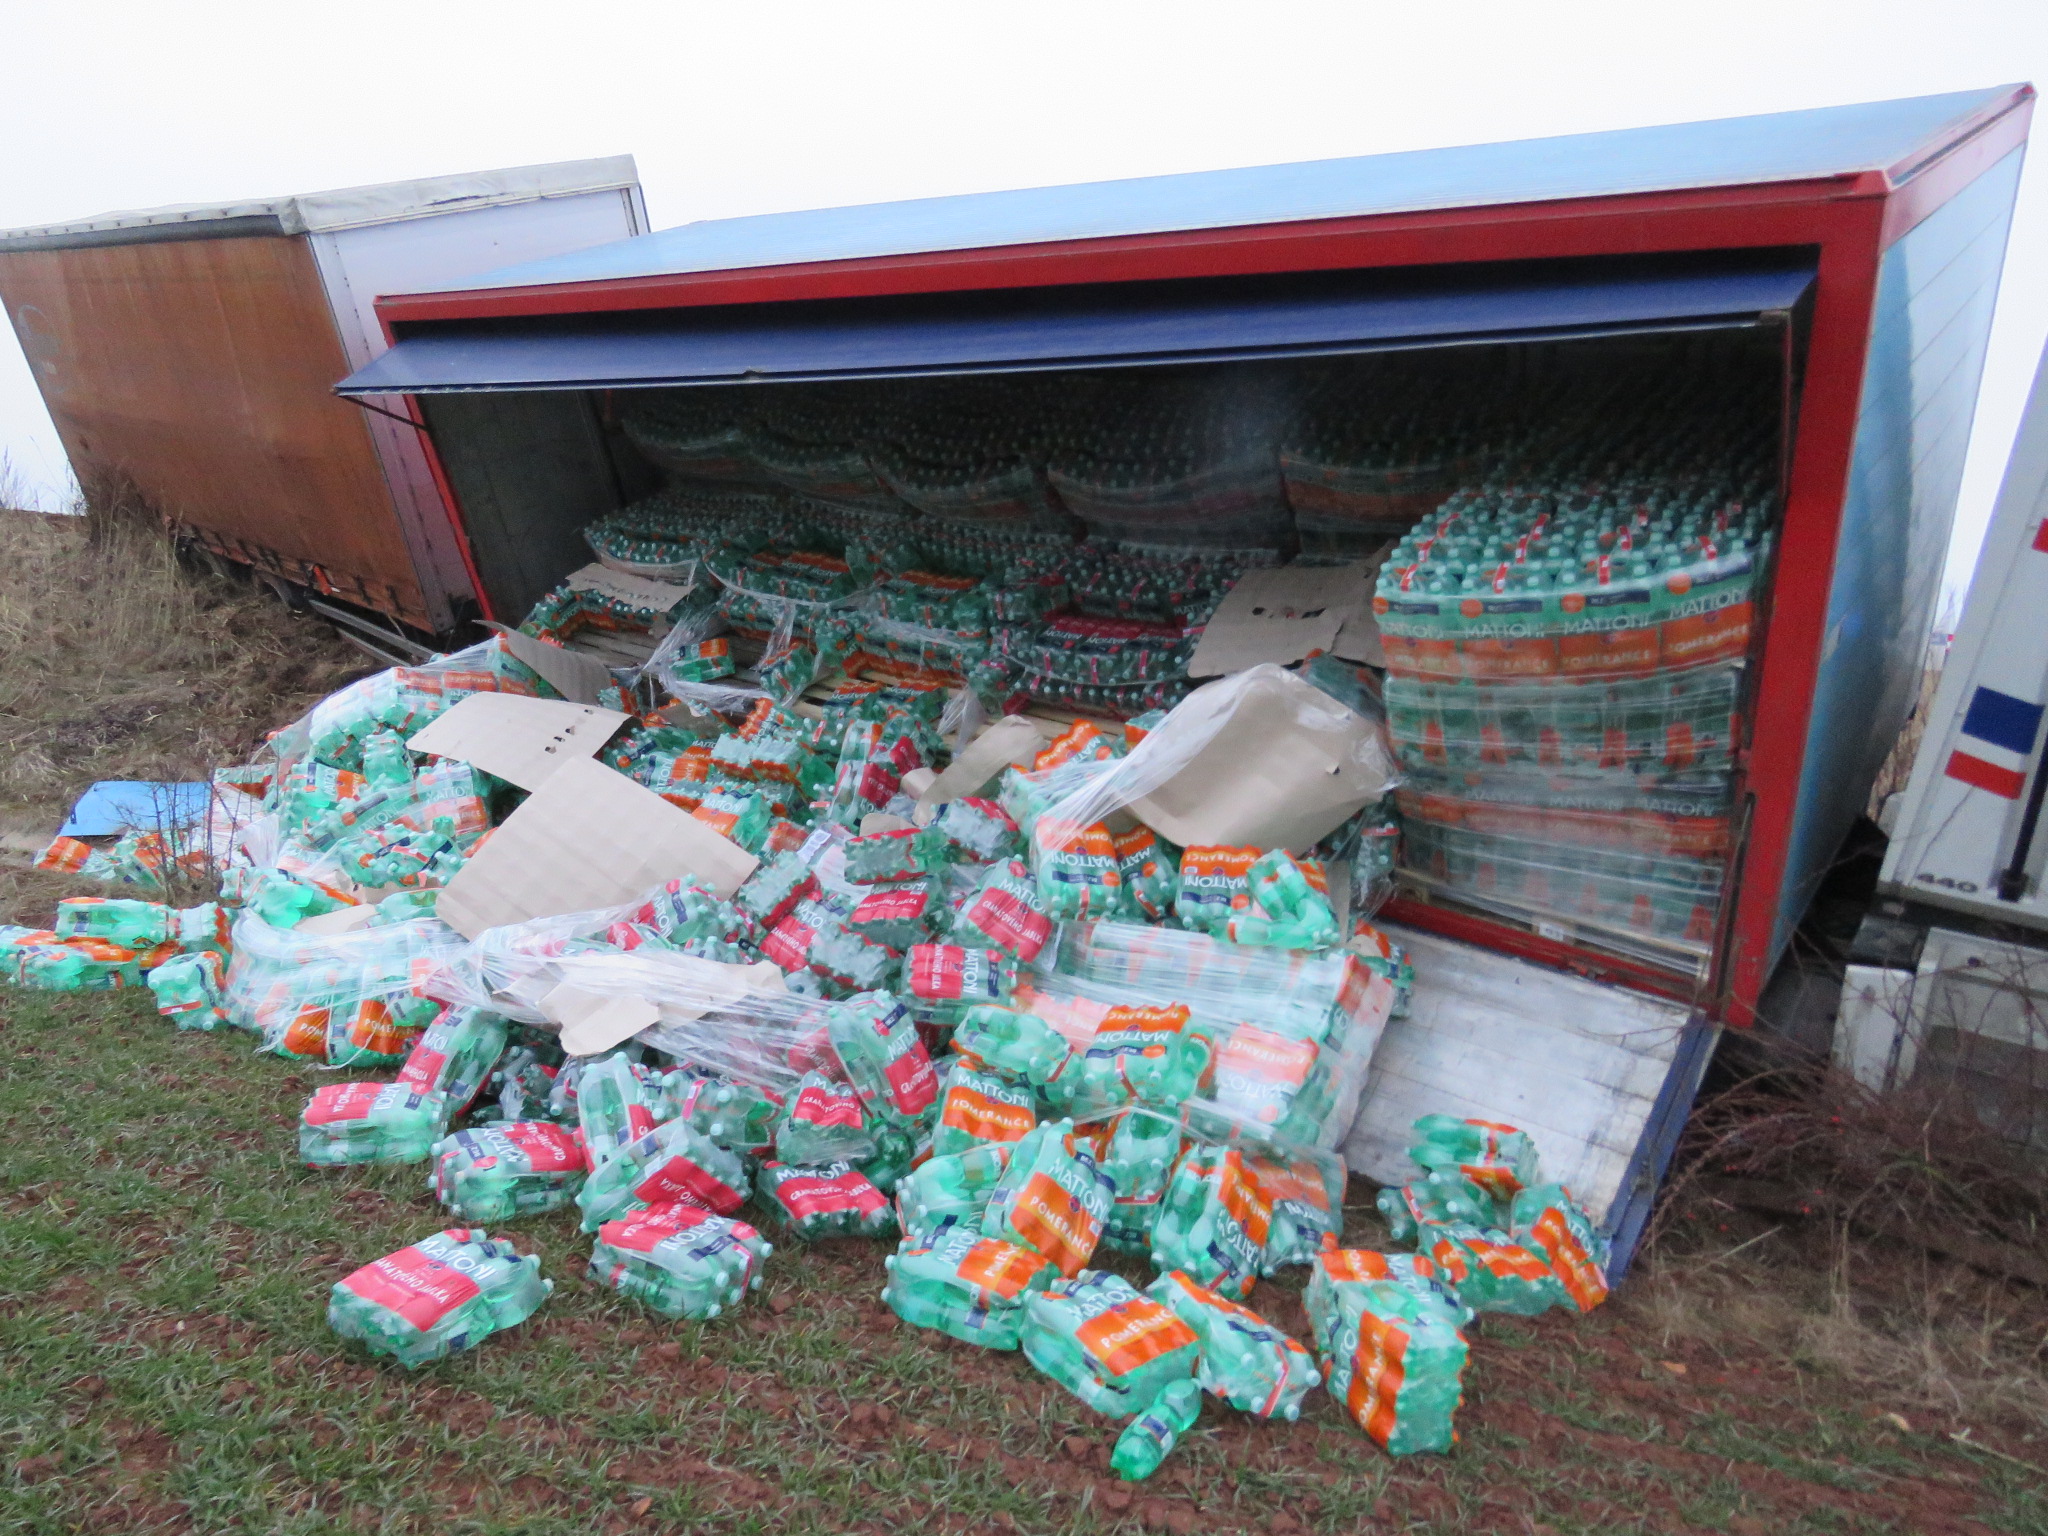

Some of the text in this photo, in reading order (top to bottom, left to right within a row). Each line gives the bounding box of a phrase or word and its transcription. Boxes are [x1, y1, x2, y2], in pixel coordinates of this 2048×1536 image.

[1184, 875, 1248, 890] MATTONI
[962, 948, 980, 995] MATTONI
[957, 1073, 1030, 1108] MATTONI
[417, 1236, 498, 1281] MATTONI
